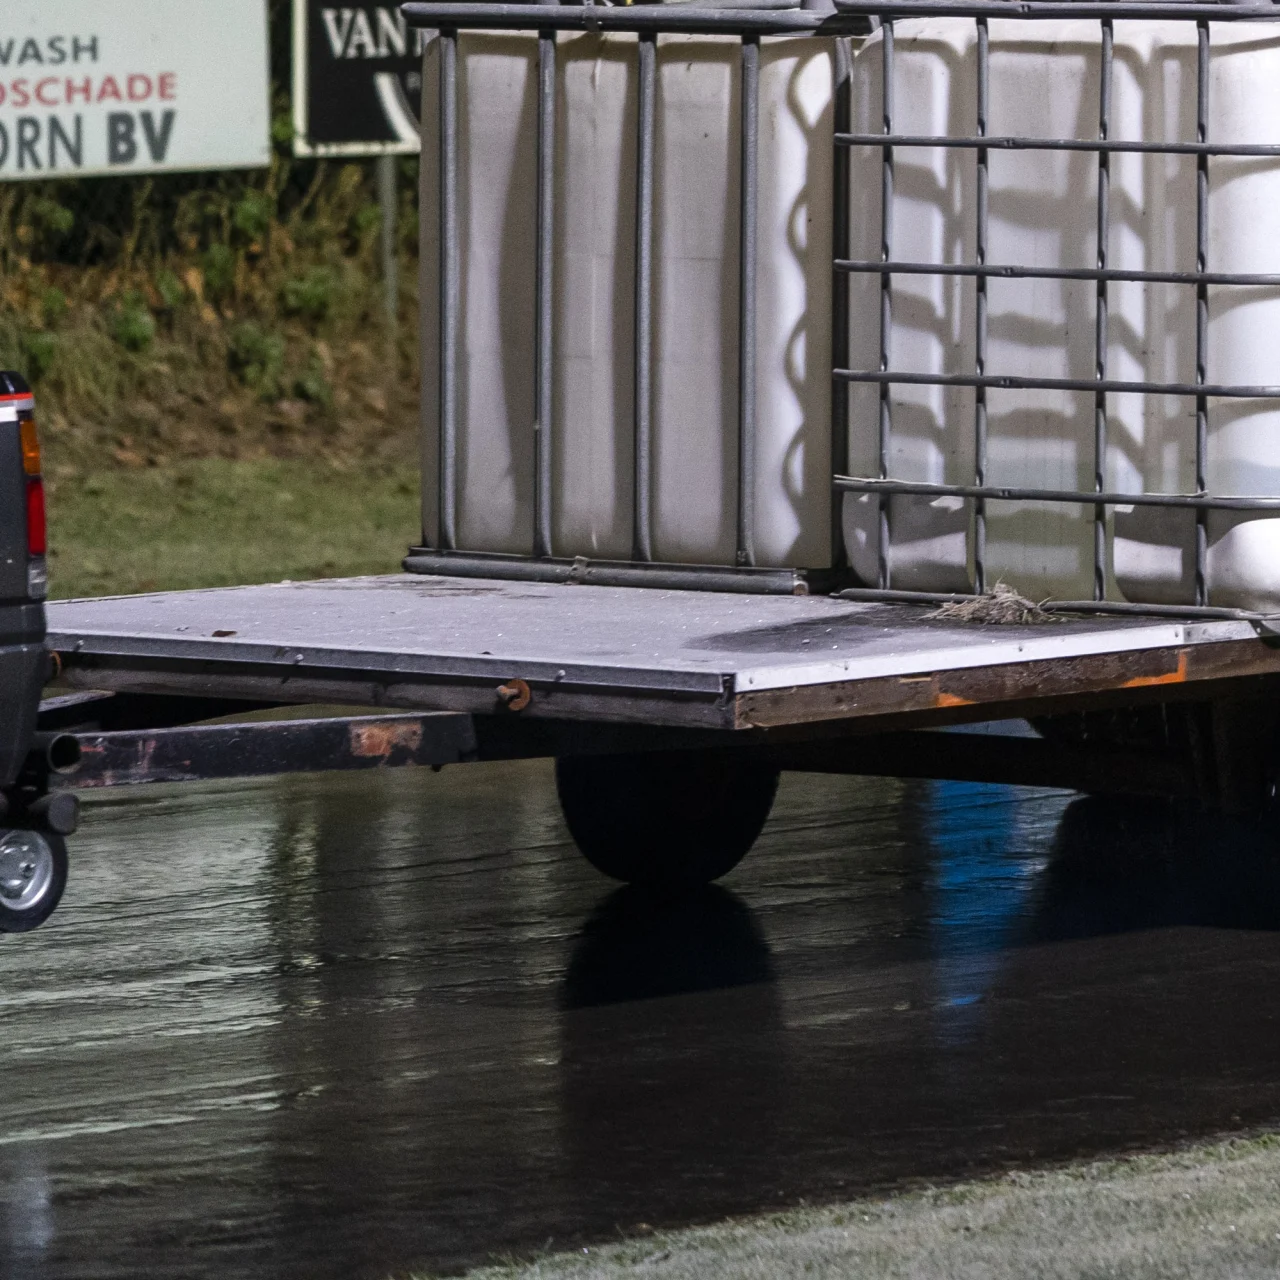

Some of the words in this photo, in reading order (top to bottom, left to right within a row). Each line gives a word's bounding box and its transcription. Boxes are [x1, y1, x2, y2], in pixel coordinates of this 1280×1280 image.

[321, 7, 407, 58] VAN
[0, 72, 177, 108] SCHADE
[106, 108, 176, 165] BV
